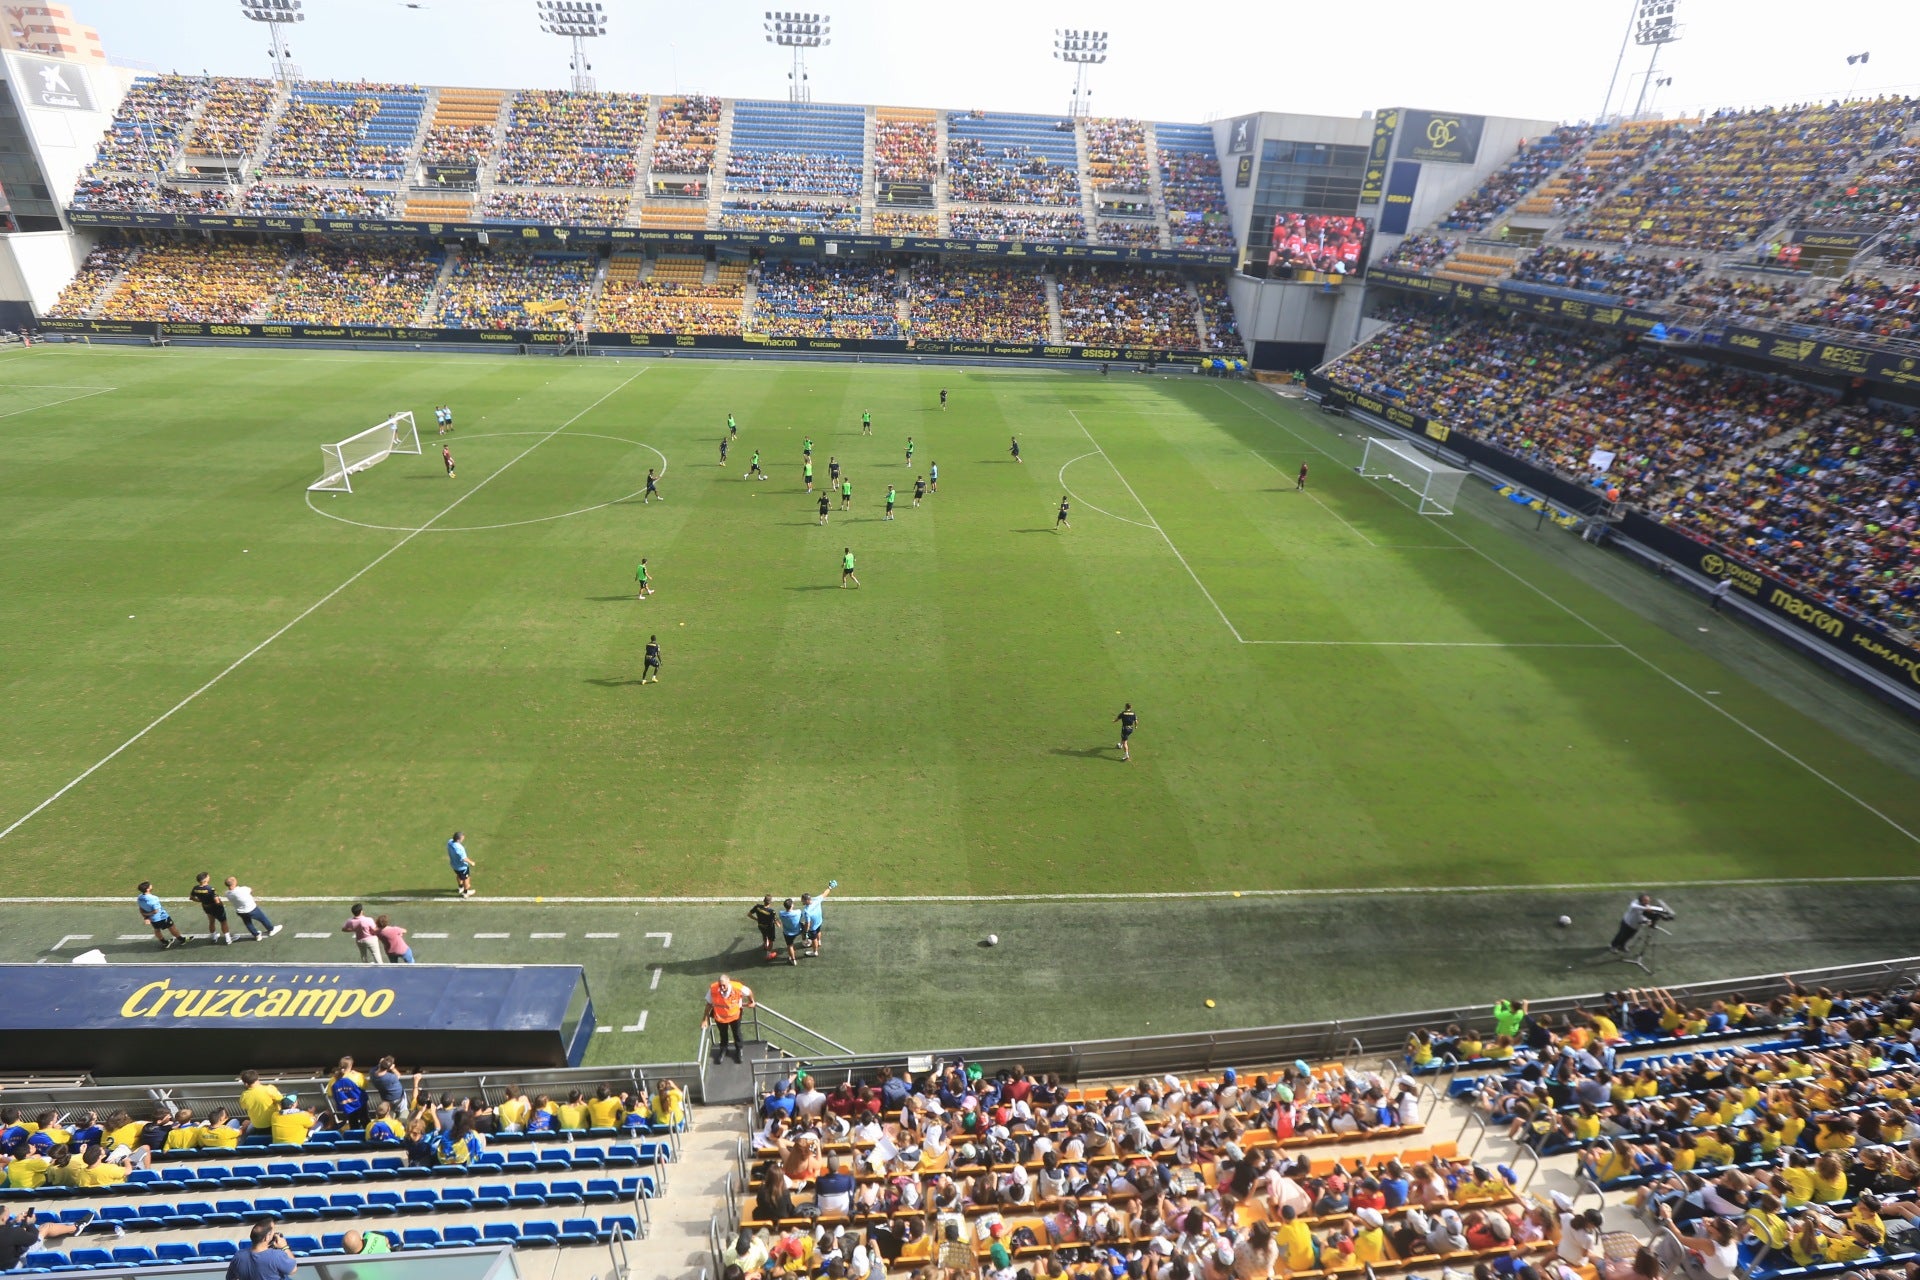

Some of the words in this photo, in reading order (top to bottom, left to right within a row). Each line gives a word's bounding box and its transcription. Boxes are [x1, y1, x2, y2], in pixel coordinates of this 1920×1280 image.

[210, 325, 242, 335] asisa
[262, 326, 292, 334] ENERYETI
[304, 329, 322, 337] Grupo
[480, 332, 513, 341] Cruzcampo
[809, 340, 841, 349] Cruzcampo
[994, 346, 1011, 354] Grupo
[1043, 346, 1072, 354] ENERYETI
[1081, 348, 1110, 358] asisa
[1820, 345, 1875, 367] RESET
[1725, 561, 1764, 588] TOYOTA
[1769, 588, 1845, 638] macron
[214, 975, 277, 984] DESDE
[120, 977, 395, 1025] Cruzcampo
[106, 1136, 115, 1150] 2
